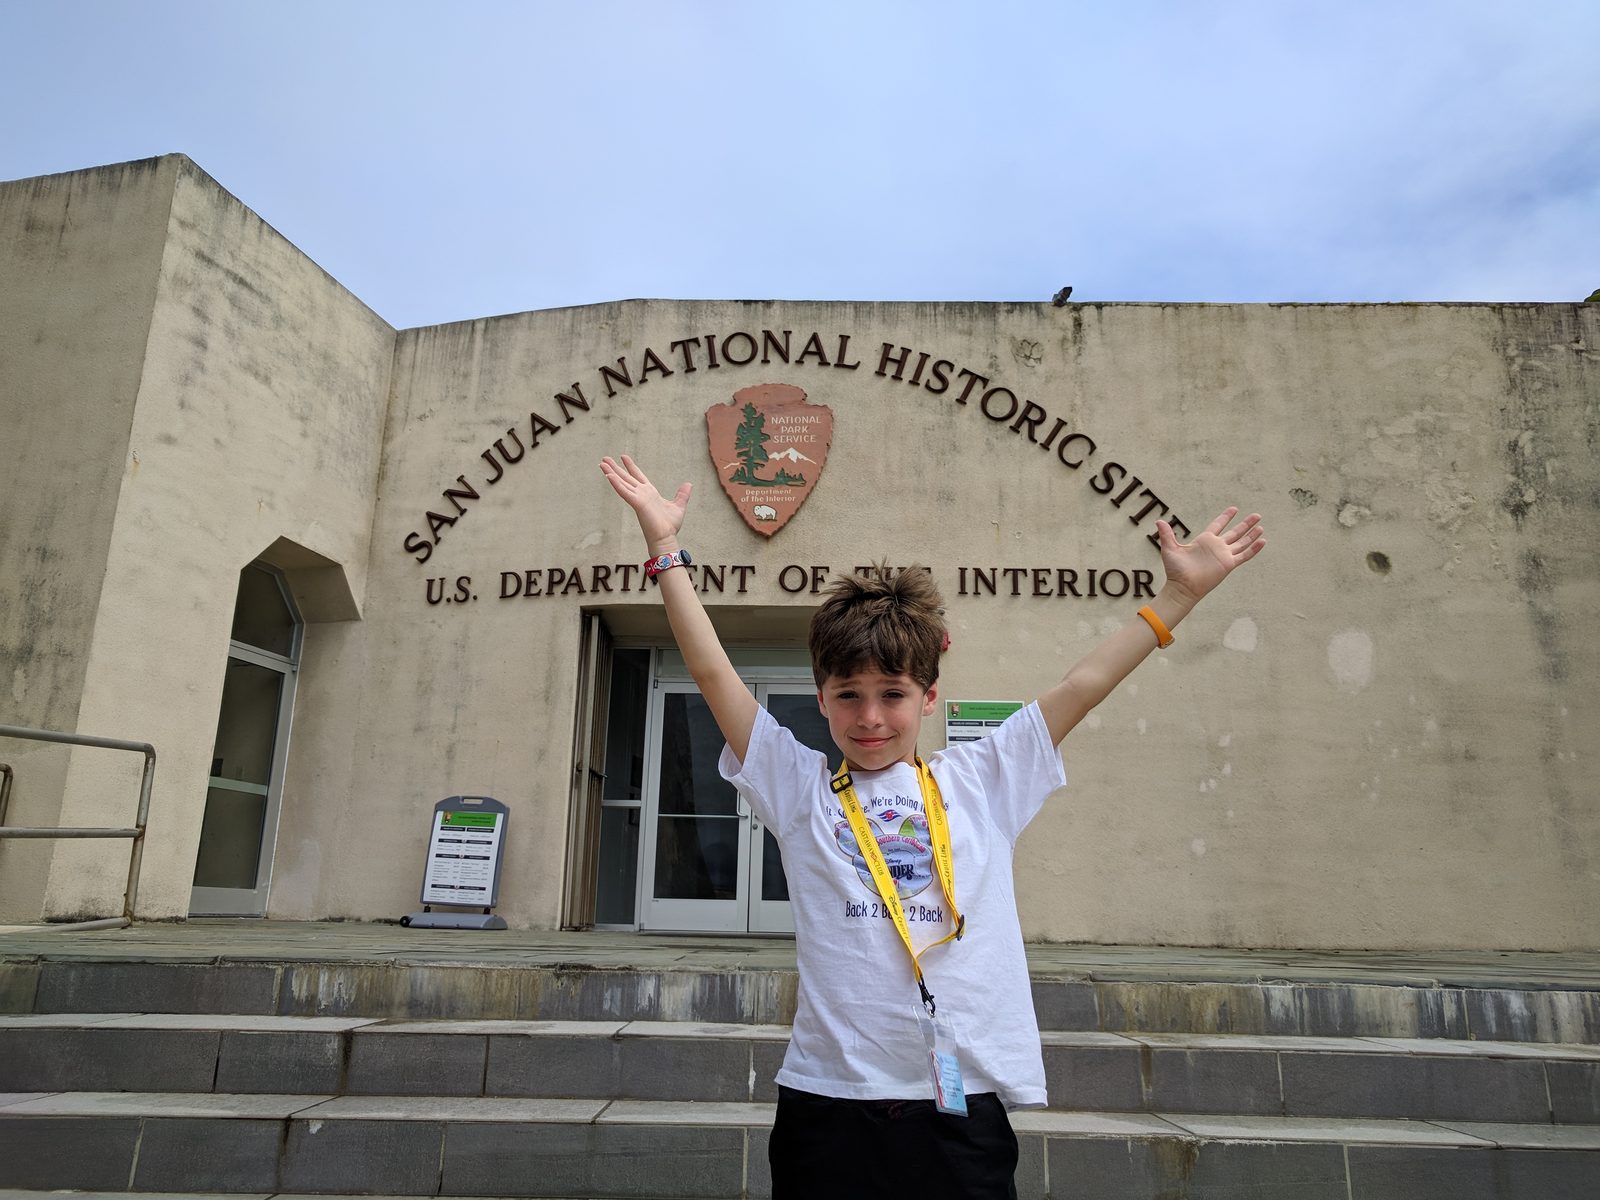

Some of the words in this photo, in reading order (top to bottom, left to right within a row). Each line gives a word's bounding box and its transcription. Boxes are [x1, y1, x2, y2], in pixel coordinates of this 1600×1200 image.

[771, 415, 822, 425] NATIONAL
[781, 425, 809, 433] PARK
[773, 434, 817, 443] SERVICE
[404, 475, 480, 564] SAN
[480, 382, 591, 485] JUAN
[599, 330, 861, 397] NATIONAL
[875, 342, 1096, 469] HISTORIC
[745, 488, 792, 496] Department
[740, 495, 749, 503] of
[751, 495, 764, 503] the
[426, 575, 478, 604] U.S.
[778, 565, 829, 594] OF
[958, 566, 1156, 597] INTERIOR
[871, 796, 892, 808] We're
[896, 795, 918, 811] Doing
[845, 900, 867, 917] Back
[871, 903, 878, 918] 2
[909, 906, 916, 921] 2
[919, 905, 943, 922] Back
